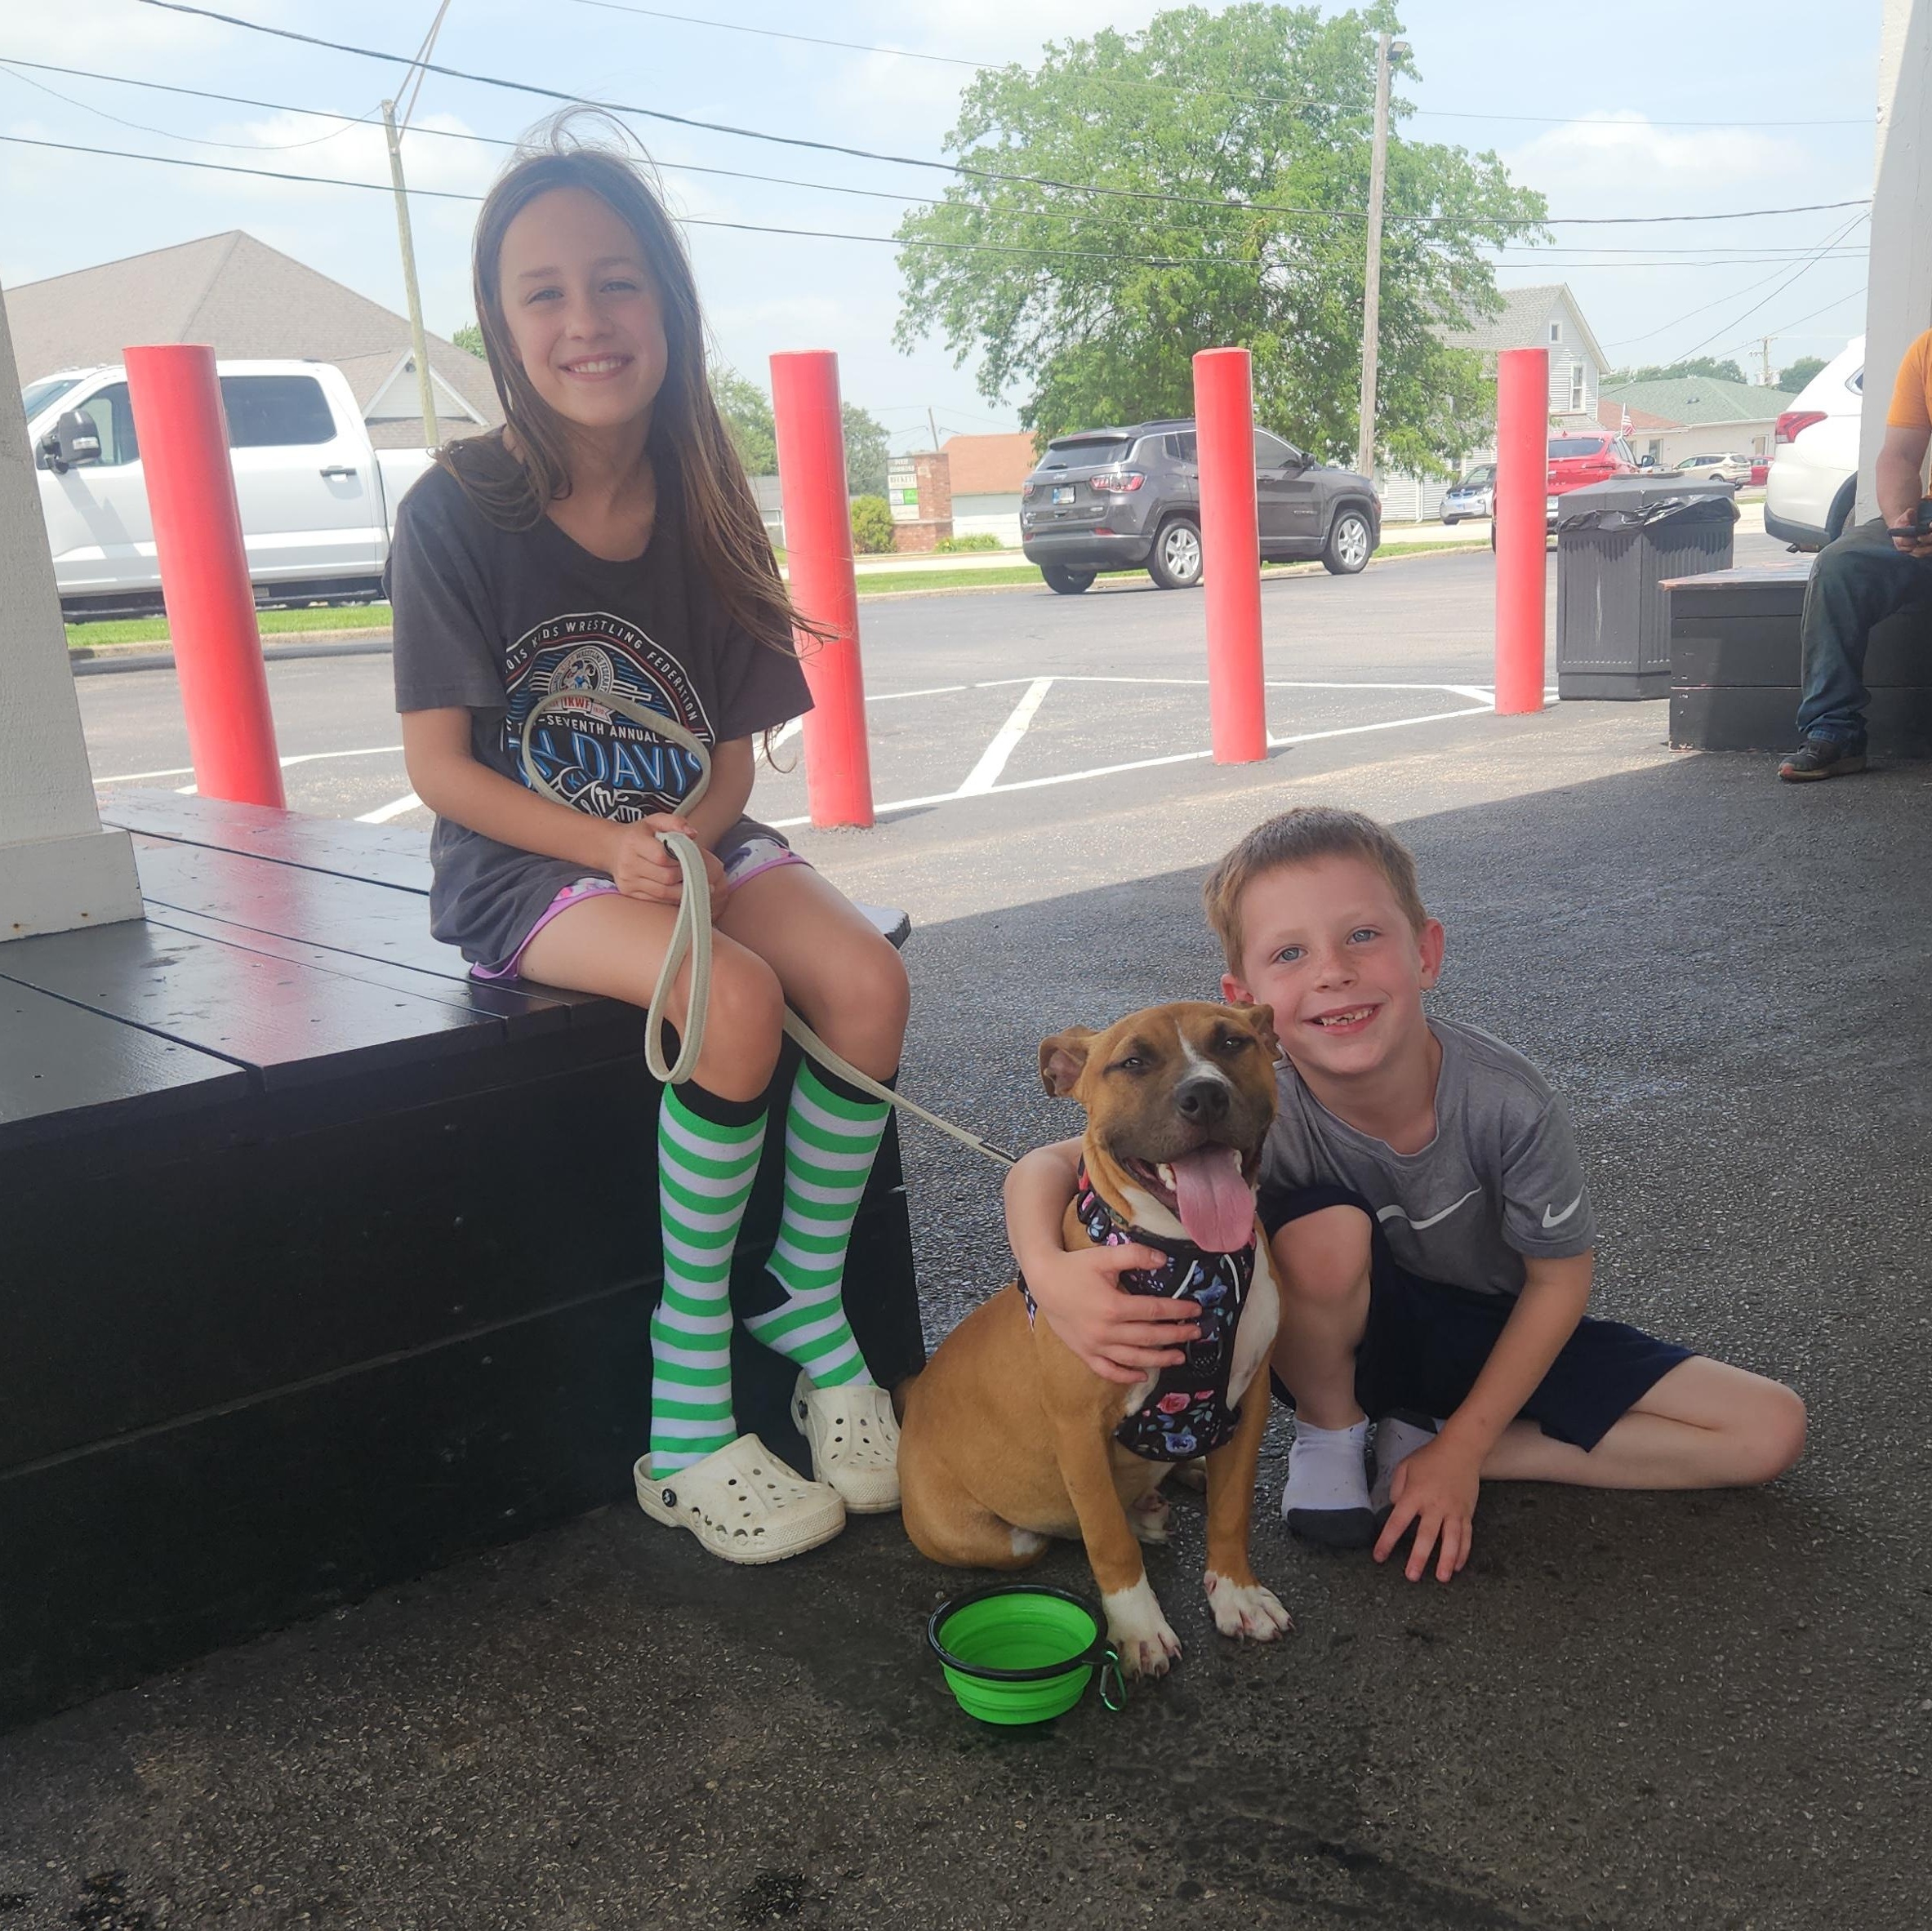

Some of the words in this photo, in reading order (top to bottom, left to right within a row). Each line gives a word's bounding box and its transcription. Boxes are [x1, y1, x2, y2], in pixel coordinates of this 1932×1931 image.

[505, 648, 528, 674] OIS
[532, 626, 559, 647] KIDS
[565, 620, 643, 650] WRESTLING
[646, 652, 698, 722] FEDERATION
[609, 724, 660, 744] ANNUAL
